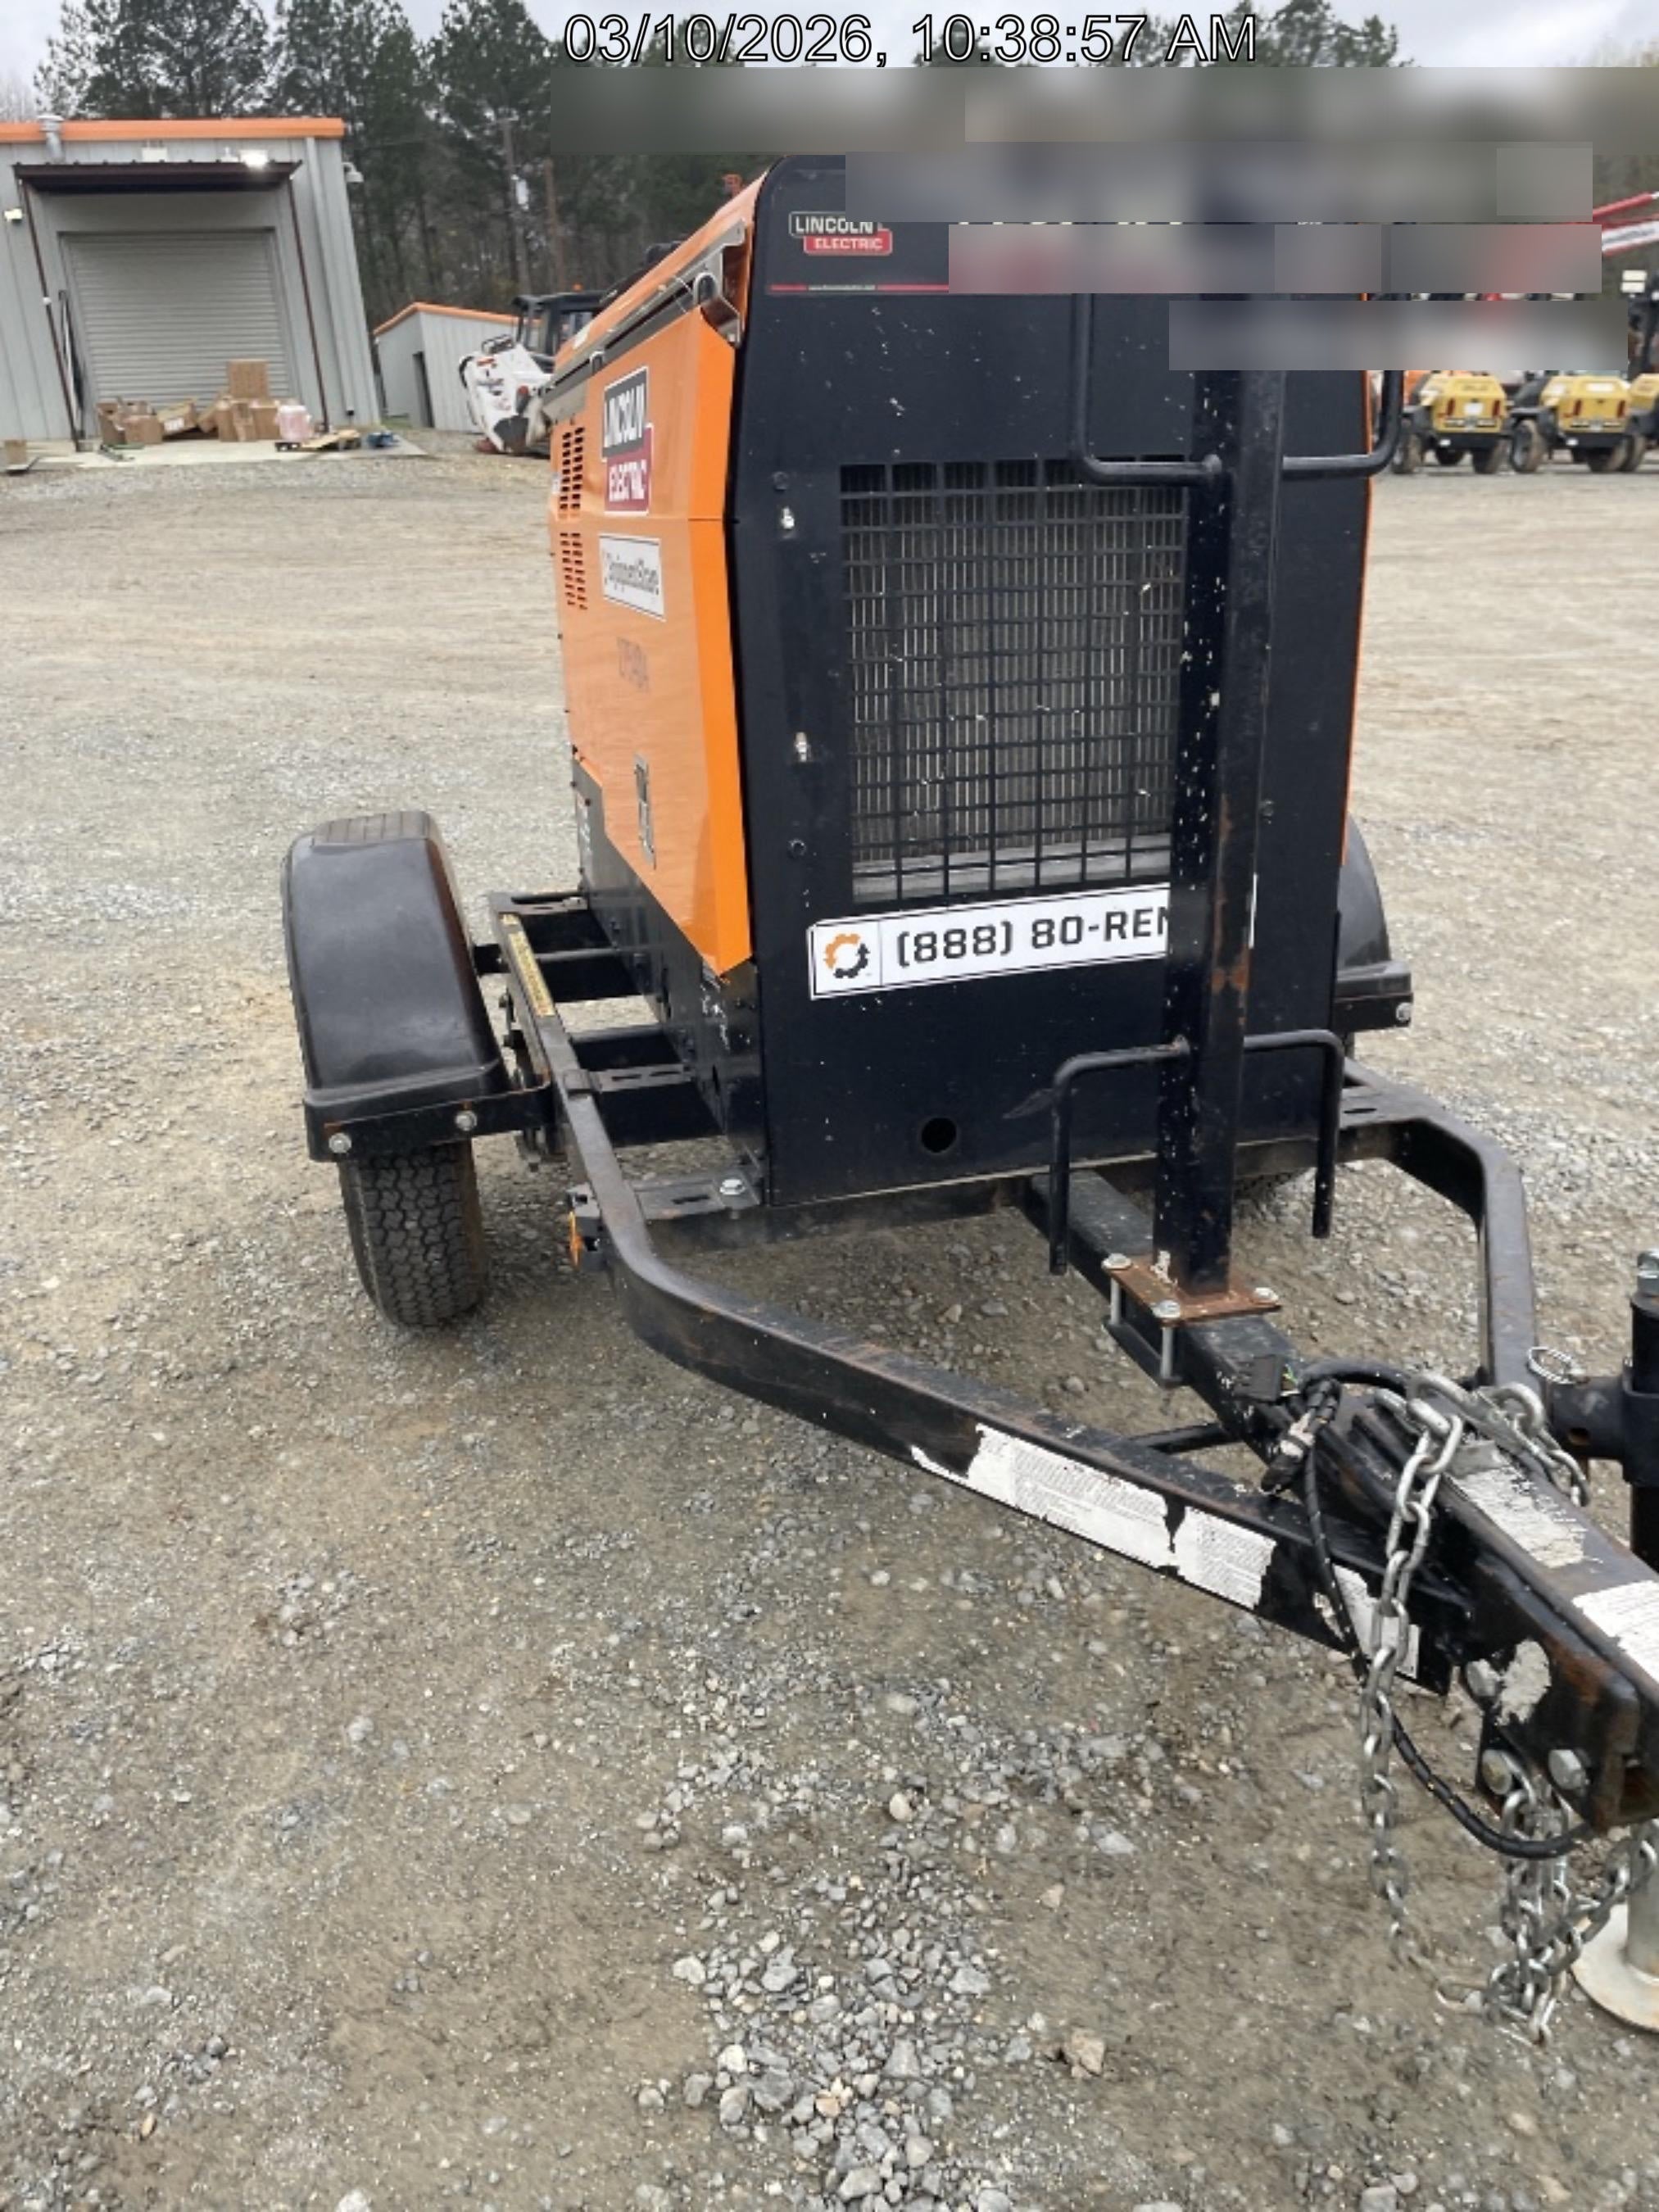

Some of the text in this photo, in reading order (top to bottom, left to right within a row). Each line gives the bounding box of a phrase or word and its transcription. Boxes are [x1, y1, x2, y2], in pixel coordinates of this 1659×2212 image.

[795, 216, 873, 233] LINCOLN
[814, 237, 884, 250] ELECTRIC
[896, 921, 1012, 968] (888)
